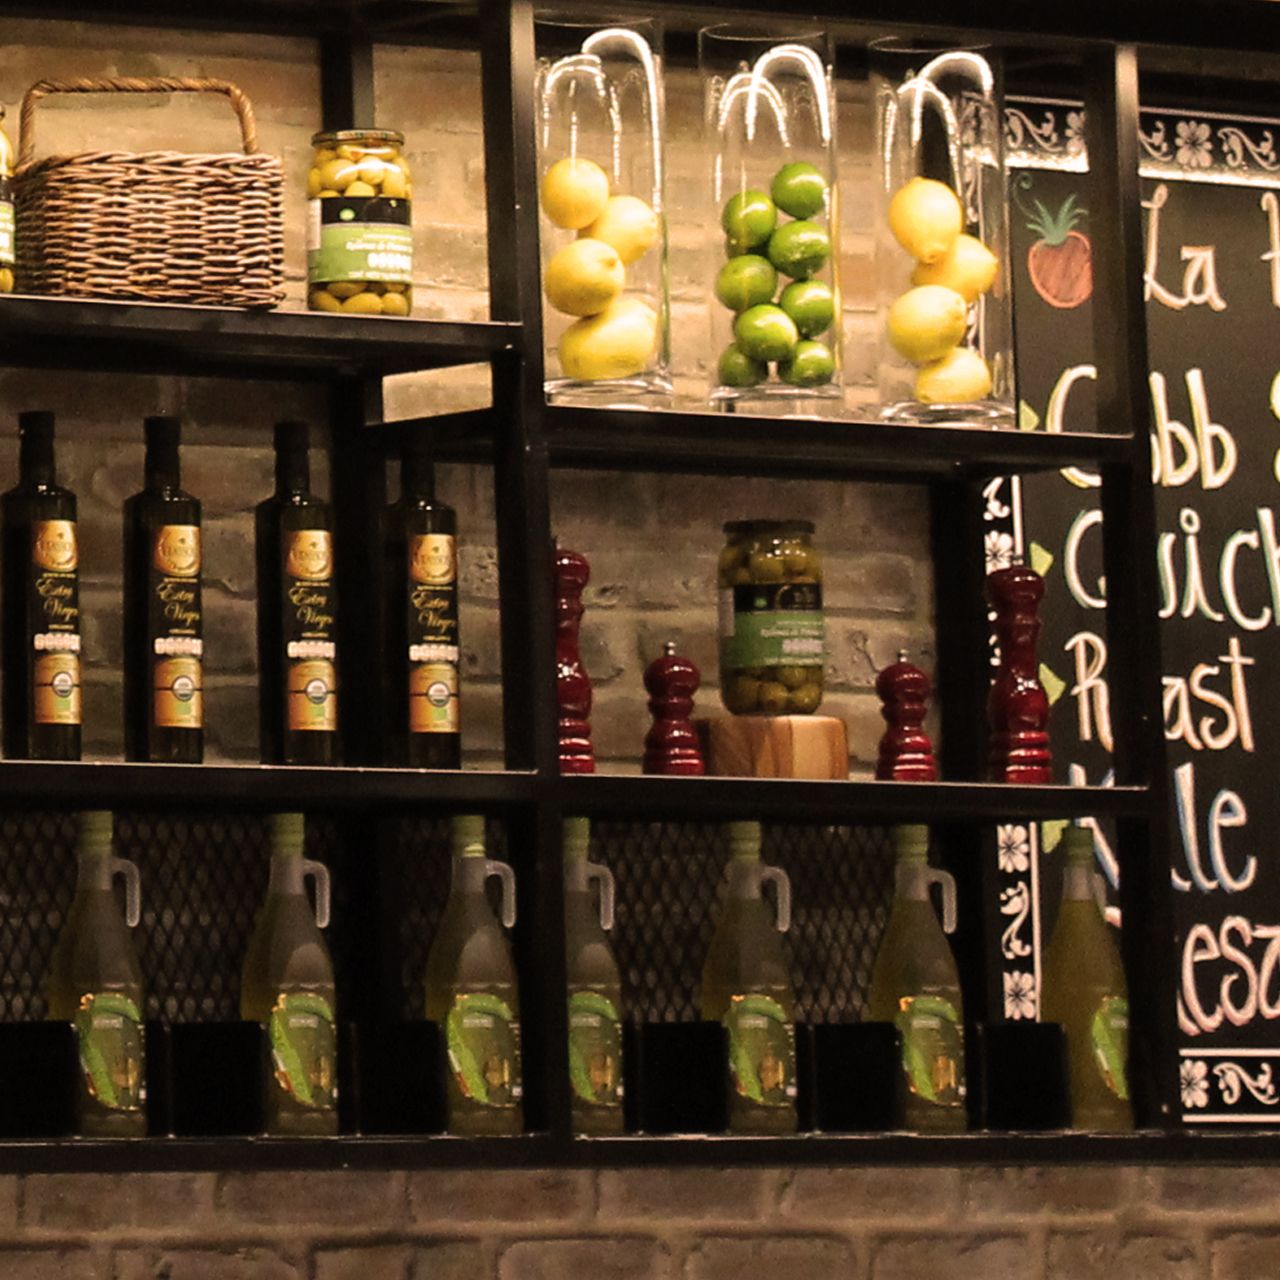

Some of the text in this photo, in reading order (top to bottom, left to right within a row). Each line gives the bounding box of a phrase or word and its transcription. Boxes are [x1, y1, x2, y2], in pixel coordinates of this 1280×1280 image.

[1141, 183, 1227, 312] La
[1046, 364, 1237, 489] Cbb
[1064, 631, 1254, 753] Rast
